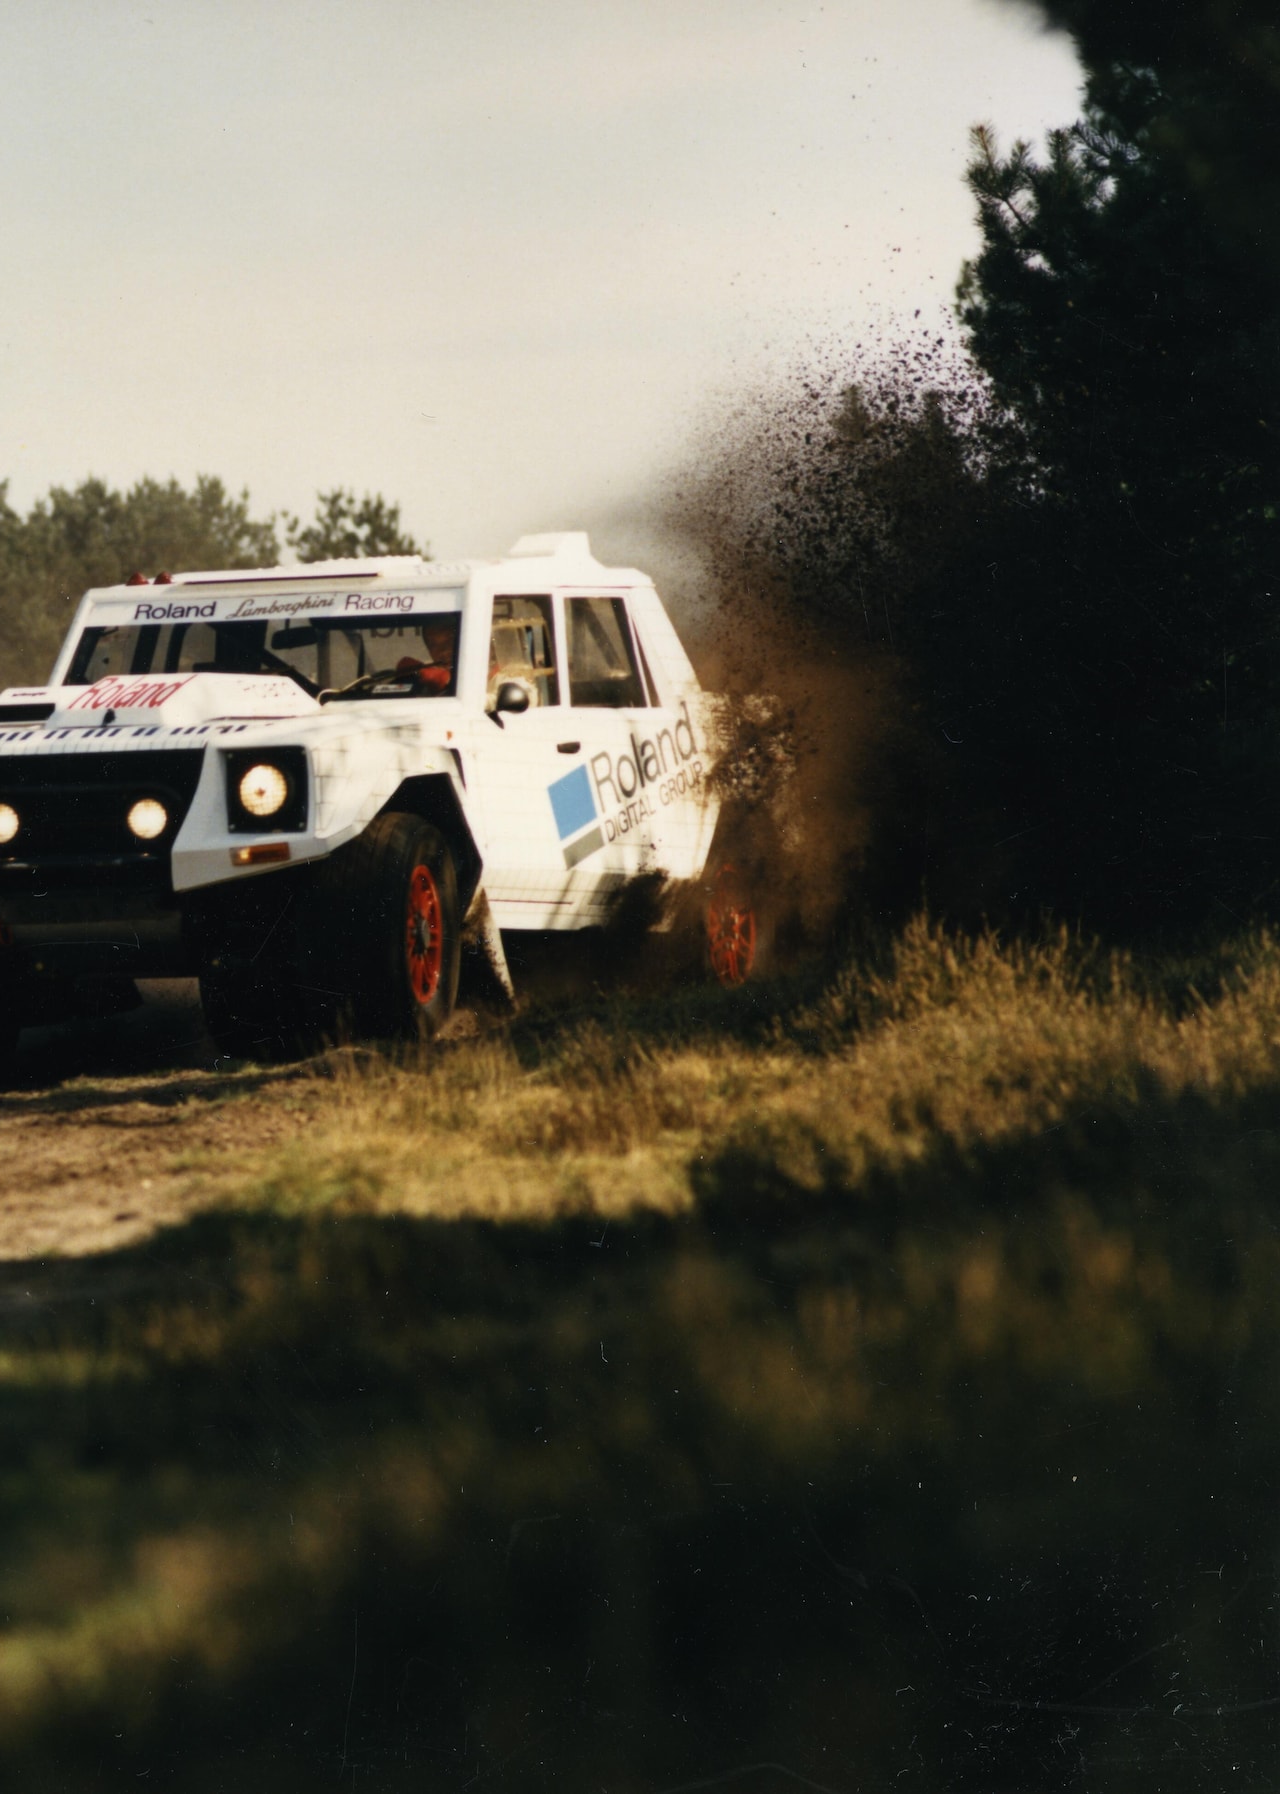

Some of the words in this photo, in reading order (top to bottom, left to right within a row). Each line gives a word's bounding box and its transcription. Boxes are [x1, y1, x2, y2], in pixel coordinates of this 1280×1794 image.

[135, 602, 216, 619] Roland
[226, 594, 335, 619] Lamborghini
[345, 592, 415, 613] Racing
[68, 674, 198, 709] Roland
[591, 699, 698, 814] Roland
[604, 796, 656, 842] DIGITAL
[659, 761, 704, 806] GROUP
